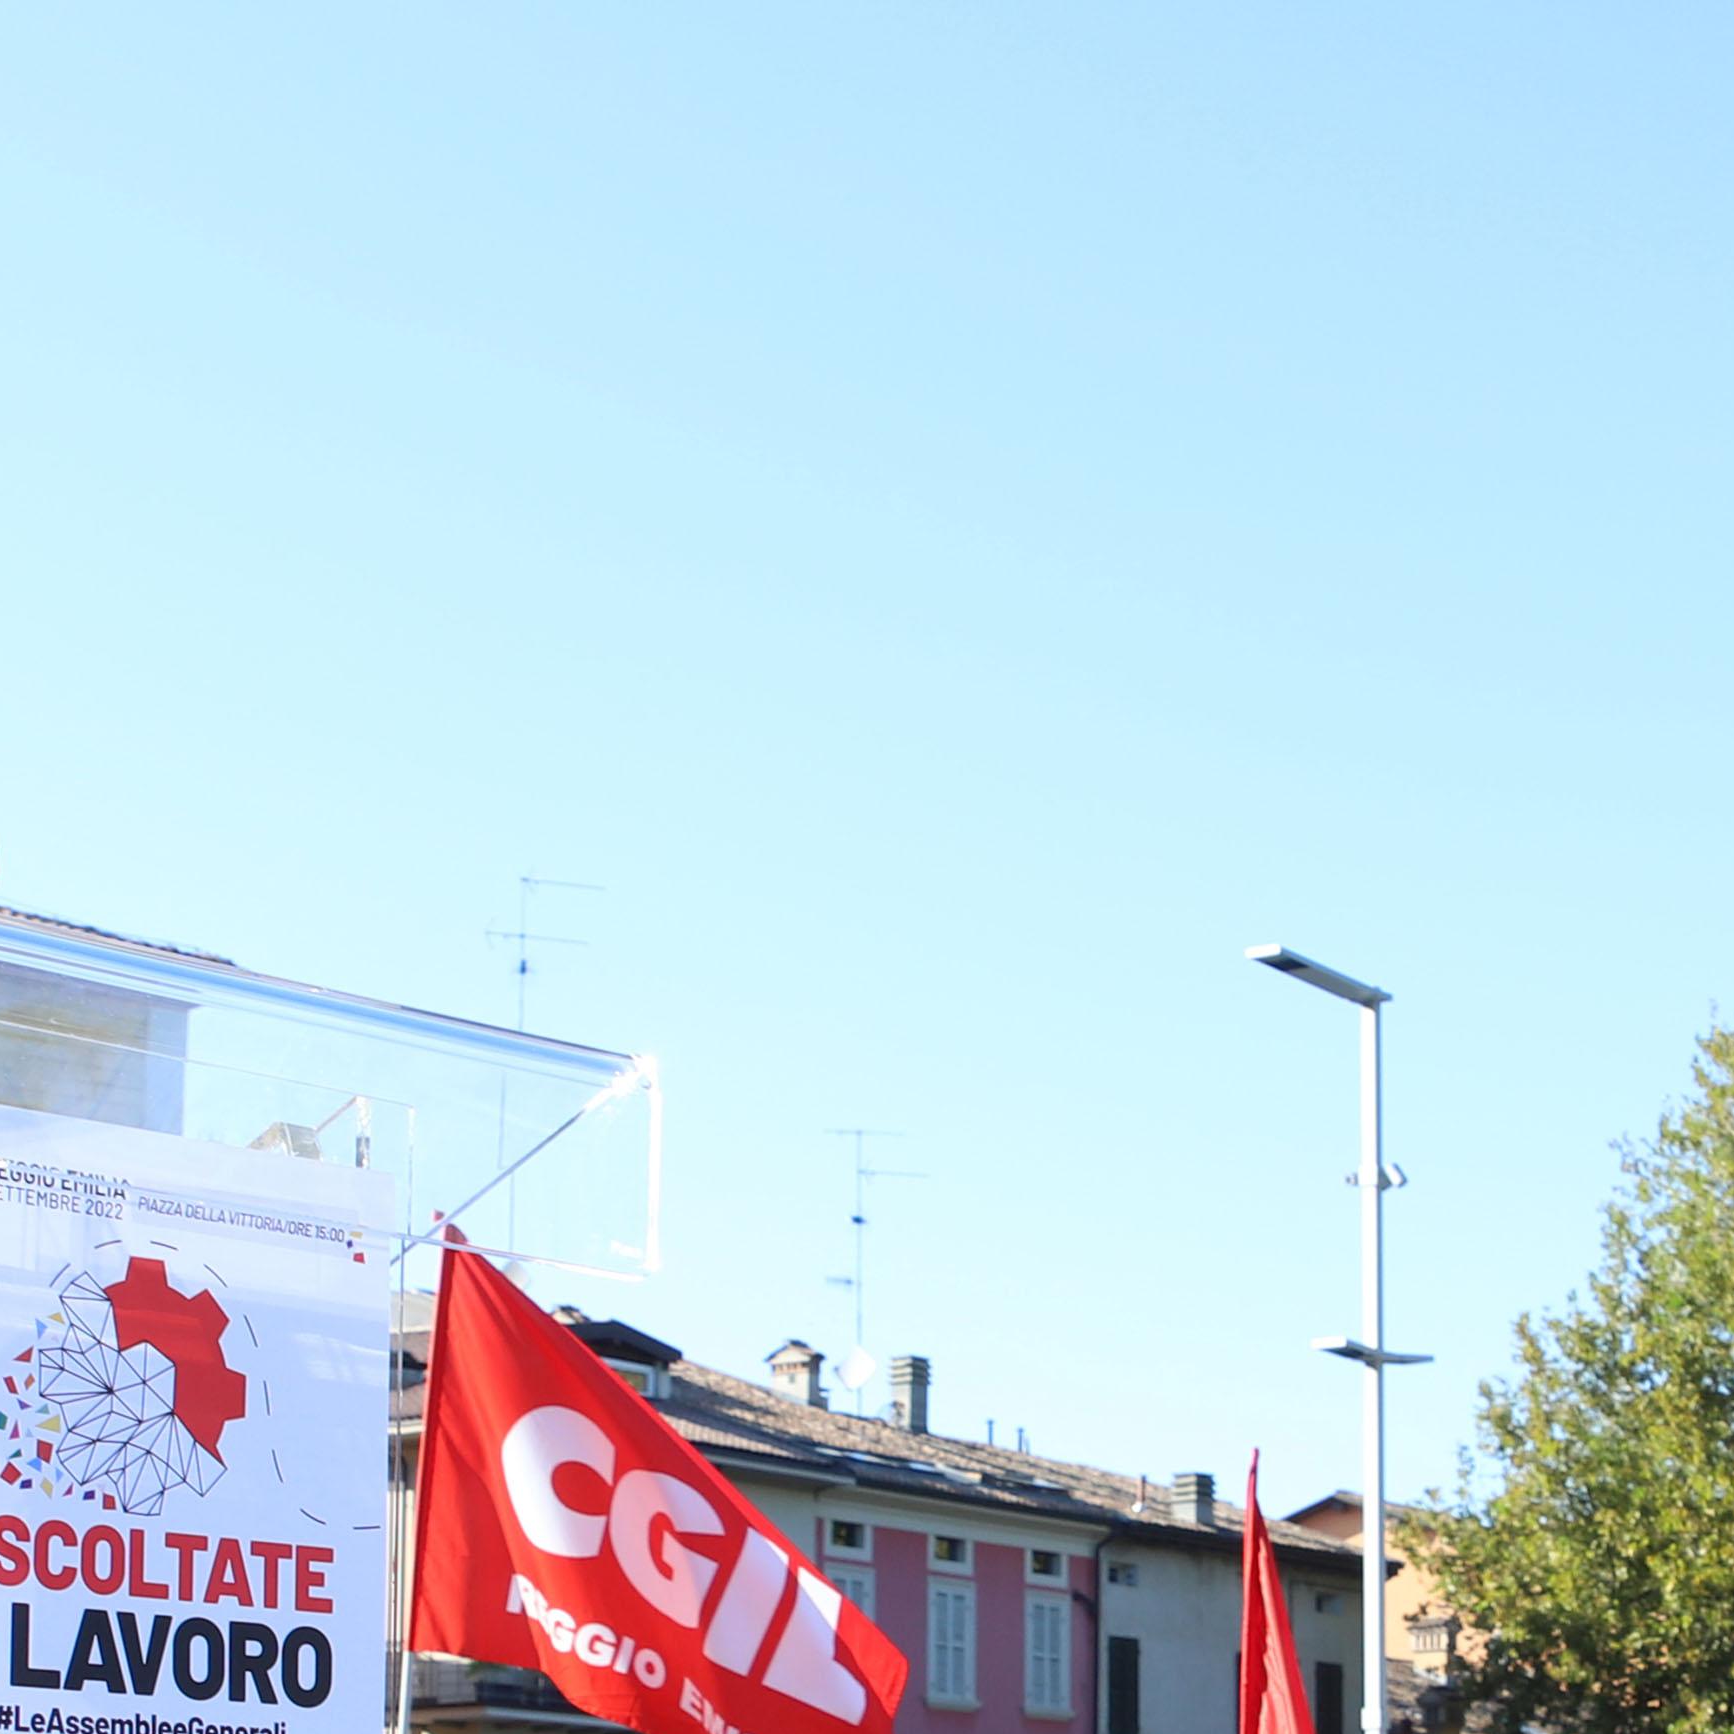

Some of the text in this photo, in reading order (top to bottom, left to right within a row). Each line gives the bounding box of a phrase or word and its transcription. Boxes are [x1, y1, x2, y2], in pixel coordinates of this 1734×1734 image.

[61, 1169, 131, 1200] EMILIA
[85, 1198, 124, 1220] 2022
[138, 1197, 183, 1217] PIAZZA
[185, 1204, 226, 1224] DELLA
[314, 1225, 345, 1243] 15:00
[502, 1405, 866, 1727] CGIL
[10, 1602, 333, 1708] LAVORO
